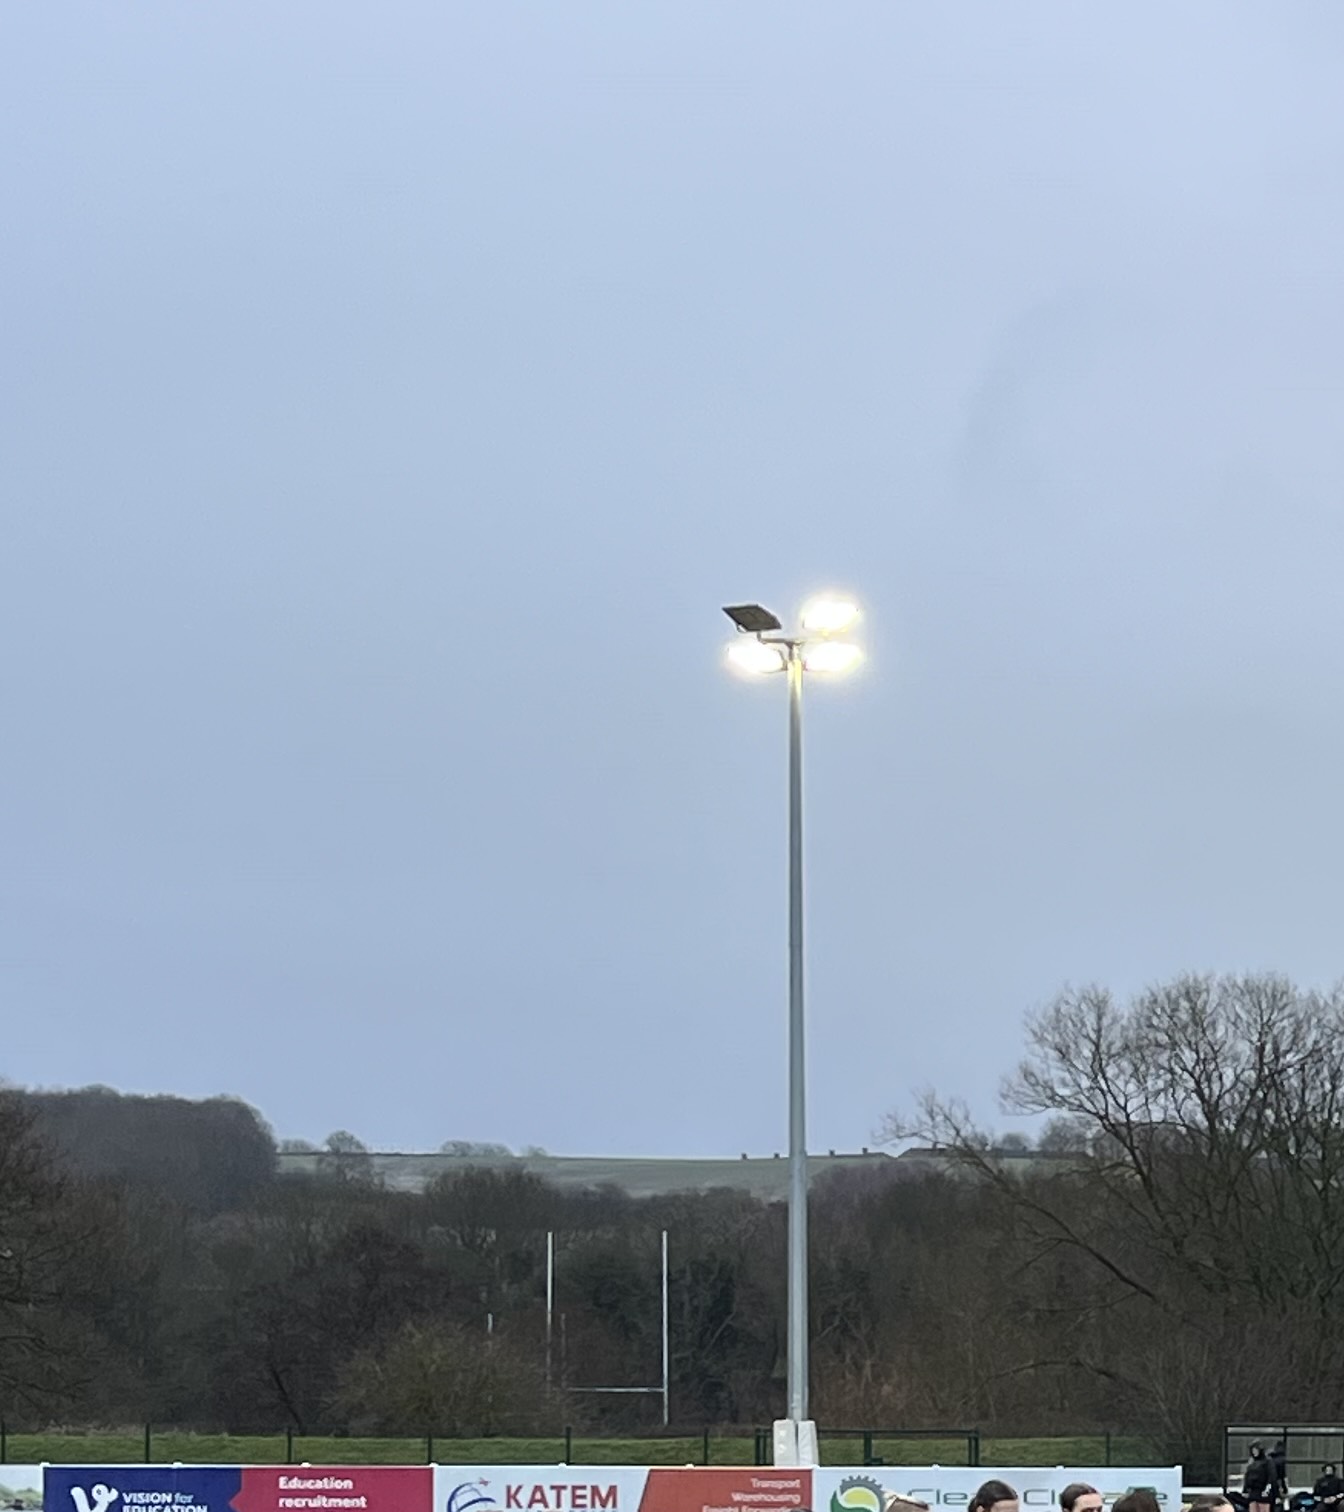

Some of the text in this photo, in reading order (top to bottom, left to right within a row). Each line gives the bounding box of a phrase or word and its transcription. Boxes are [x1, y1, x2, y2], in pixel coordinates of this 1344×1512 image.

[278, 1476, 353, 1490] Education
[750, 1478, 801, 1490] Transport
[122, 1492, 195, 1504] VISION for
[278, 1495, 367, 1509] recruitment
[505, 1484, 619, 1509] KATEM
[731, 1492, 801, 1504] Warehousing
